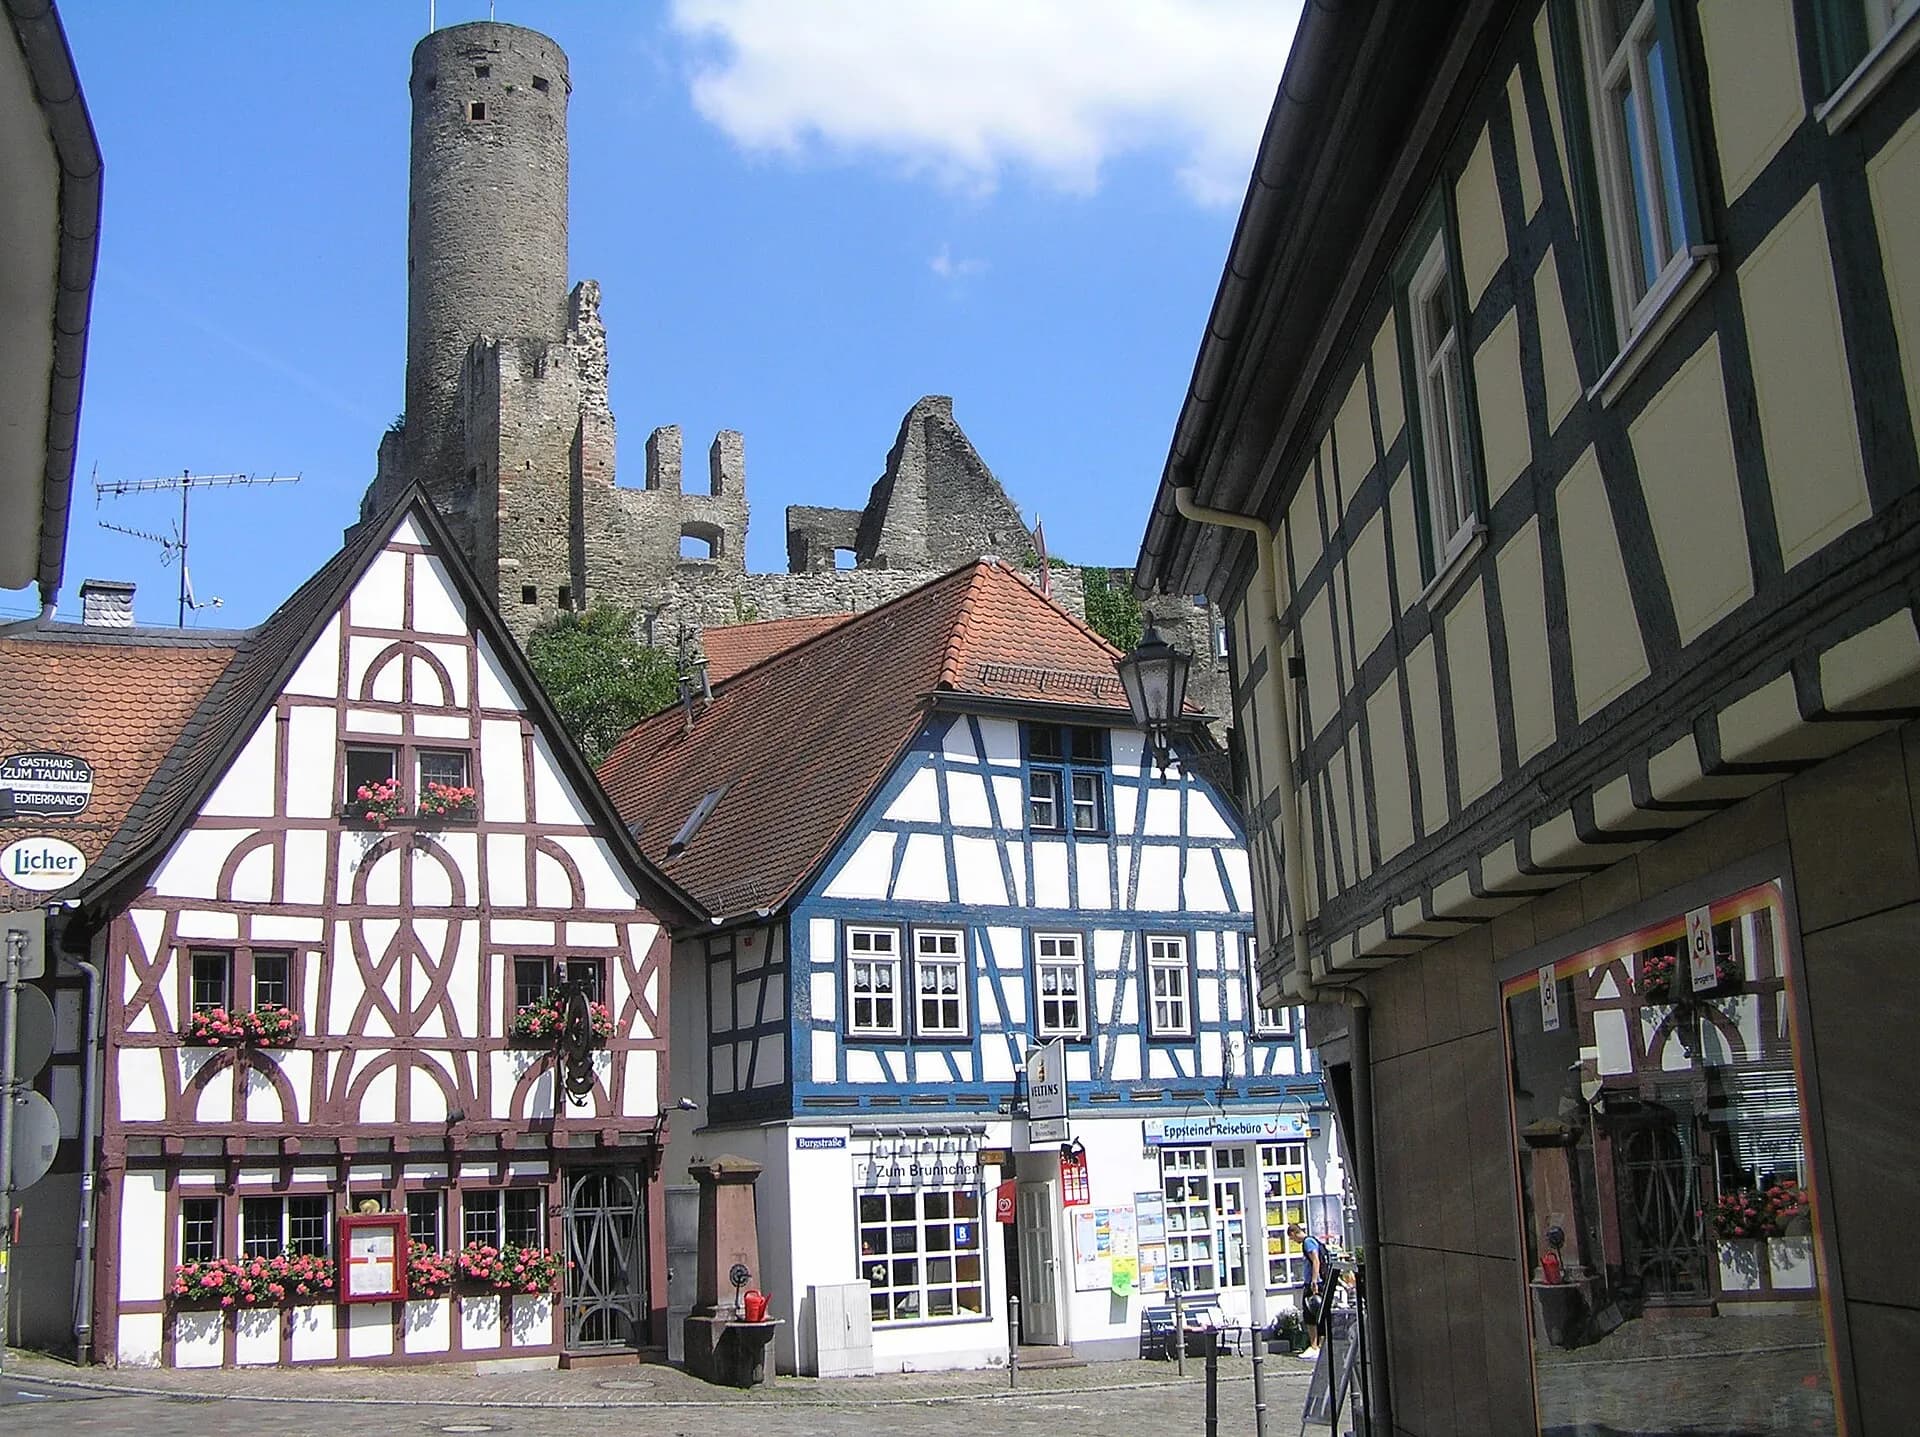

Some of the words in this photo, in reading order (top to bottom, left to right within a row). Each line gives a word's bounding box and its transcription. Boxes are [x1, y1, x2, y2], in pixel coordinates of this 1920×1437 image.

[19, 757, 74, 769] GASTHAUS
[3, 767, 32, 779] ZUM
[36, 768, 88, 781] TAUNUS
[14, 793, 85, 806] EDITERRANEO
[14, 848, 78, 875] Licher
[1031, 1084, 1059, 1097] VELTINS
[1164, 1123, 1213, 1139] Eppsteiner
[1217, 1121, 1262, 1136] Reisebüro
[800, 1137, 843, 1149] Burgstraße
[876, 1165, 905, 1178] Zum
